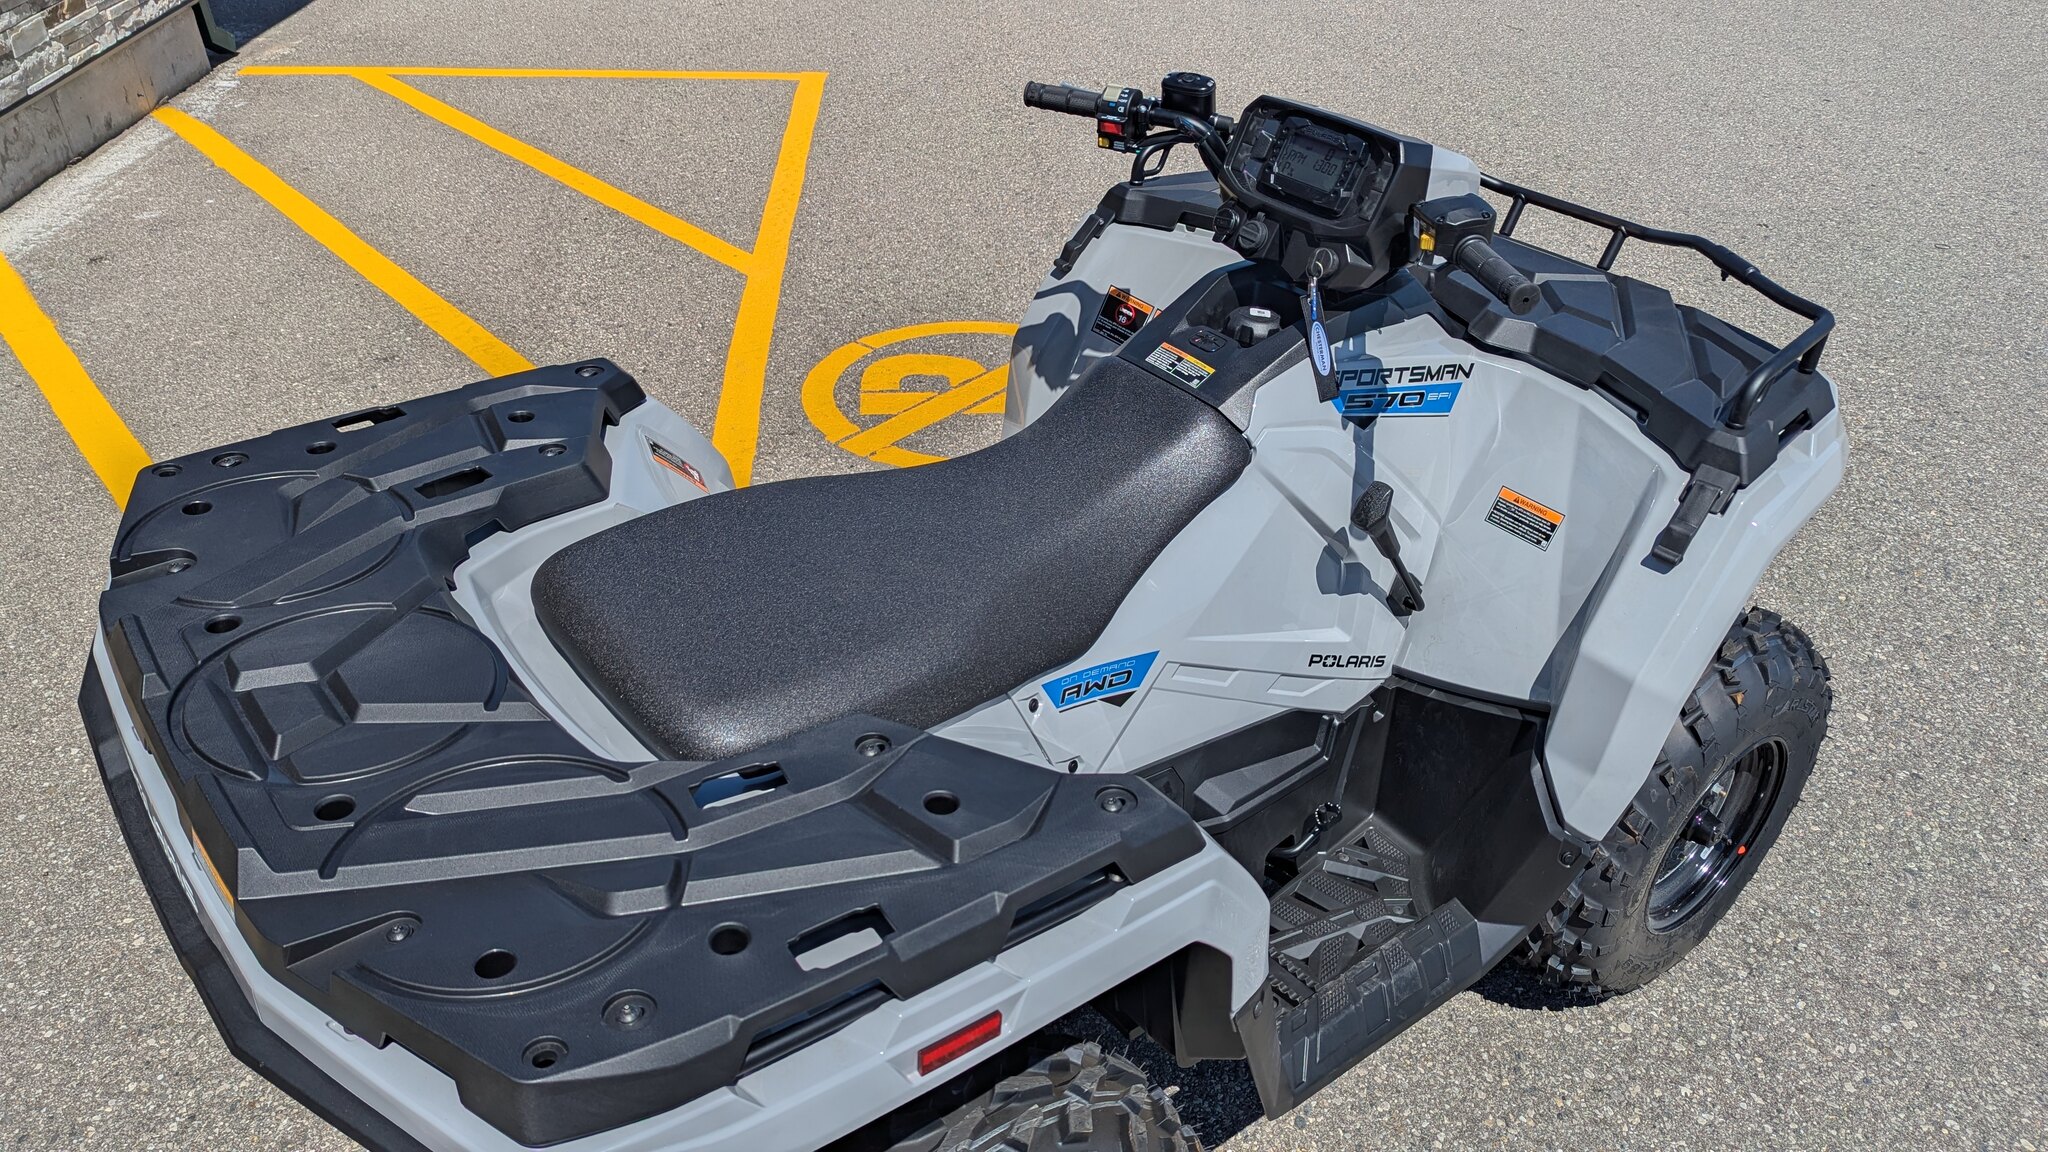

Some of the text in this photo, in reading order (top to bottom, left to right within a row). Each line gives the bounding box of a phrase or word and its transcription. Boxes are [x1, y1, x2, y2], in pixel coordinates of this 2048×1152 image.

[1118, 315, 1127, 324] 16
[1315, 327, 1327, 372] CHESTERMAN
[1344, 390, 1452, 411] 570 EFI
[1519, 498, 1548, 516] WARNING
[1308, 654, 1386, 668] POLARIS
[1061, 659, 1136, 686] ON DEMAND
[1059, 668, 1133, 706] AWD
